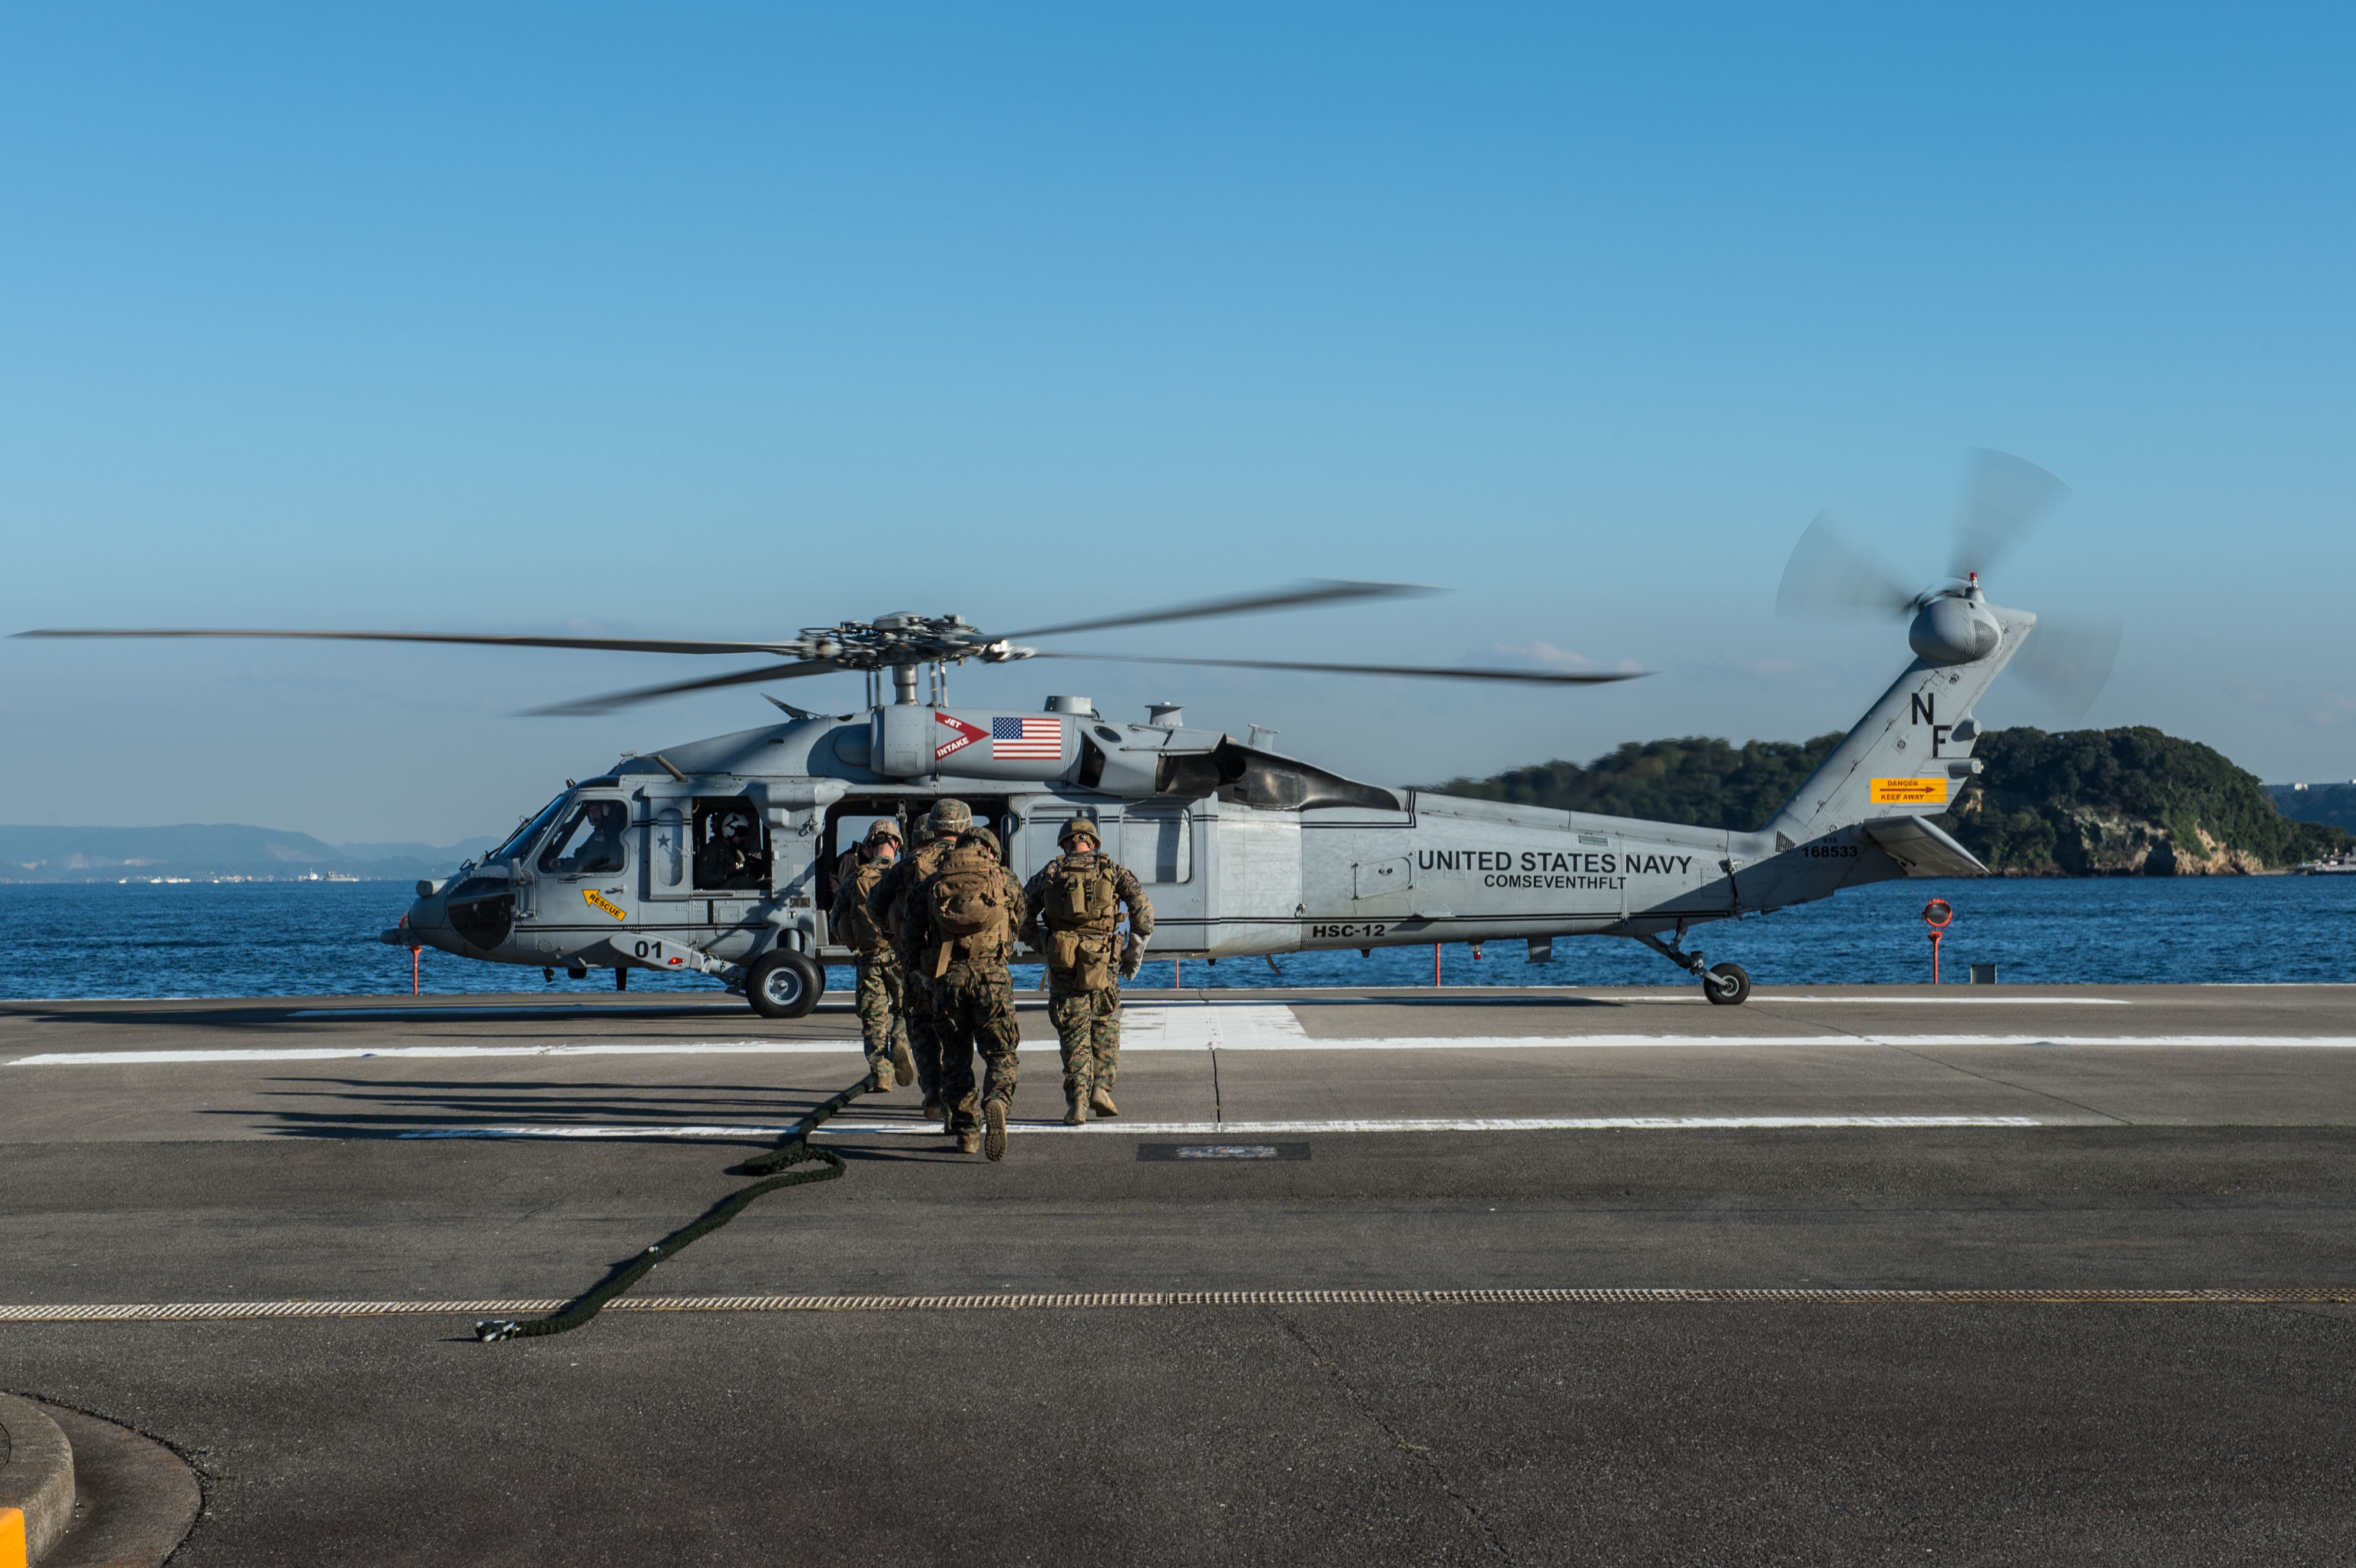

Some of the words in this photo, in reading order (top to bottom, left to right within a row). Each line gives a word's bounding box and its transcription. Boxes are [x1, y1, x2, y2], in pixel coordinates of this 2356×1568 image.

[1911, 693, 1934, 725] N
[944, 718, 962, 728] JET
[937, 737, 969, 757] INTAKE
[1933, 725, 1952, 757] F
[1802, 845, 1858, 858] 168533
[1418, 850, 1512, 871] UNITED
[1520, 852, 1616, 873] STATES
[1626, 854, 1692, 874] NAVY
[1484, 874, 1627, 889] COMSEVENTHFLT
[589, 894, 621, 917] RESCUE
[1312, 924, 1385, 938] HSC-12
[634, 941, 661, 959] 01
